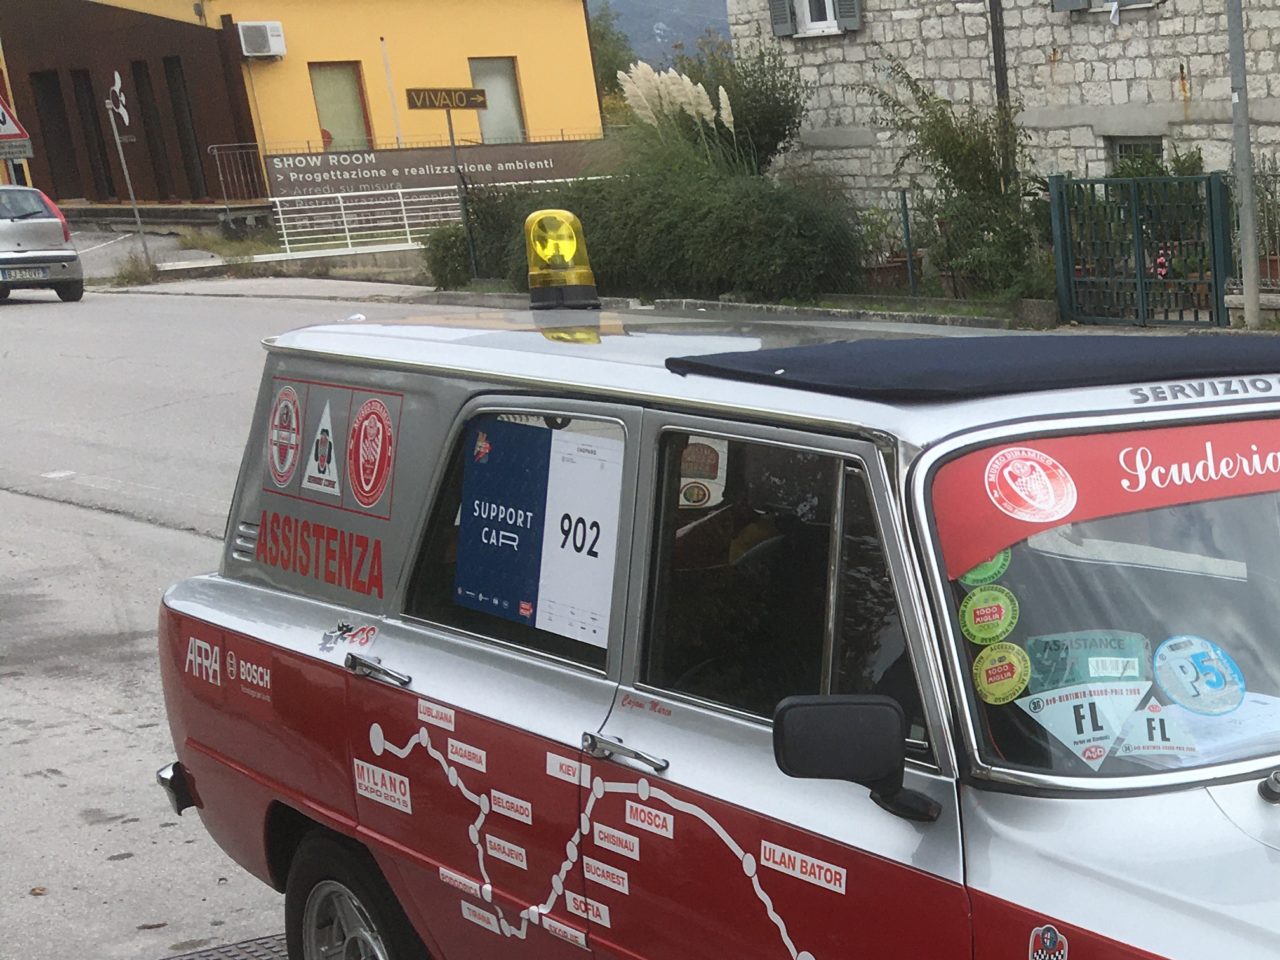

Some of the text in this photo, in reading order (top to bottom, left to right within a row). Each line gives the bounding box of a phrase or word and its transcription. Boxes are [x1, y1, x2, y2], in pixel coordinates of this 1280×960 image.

[411, 91, 467, 107] VIVAIO
[273, 153, 376, 169] SHOW ROOM
[289, 167, 387, 182] Progettazione
[404, 162, 493, 176] realizzazione
[496, 158, 554, 171] ambienti
[359, 180, 403, 192] misura
[1129, 375, 1273, 404] SERVIZIO
[473, 500, 533, 529] SUPPORT
[481, 527, 519, 551] CAR
[560, 513, 601, 558] 902
[256, 510, 384, 599] ASSISTENZA
[975, 606, 998, 616] 1000
[975, 613, 1000, 623] MIGLIA
[1043, 638, 1125, 652] ASSISTANCE
[185, 637, 221, 686] AFRA
[988, 665, 1009, 675] 1000
[239, 660, 271, 689] BOSCH
[988, 671, 1012, 683] MIGLIA
[1031, 701, 1042, 710] 36
[1073, 702, 1104, 735] FL
[1146, 717, 1171, 742] FL
[450, 743, 484, 766] ZAGABRIA
[356, 764, 407, 797] MILANO
[559, 762, 577, 778] KIEV
[357, 782, 409, 808] EXPO 2015
[492, 795, 530, 818] BELGRADO
[629, 805, 669, 833] MOSCA
[488, 839, 524, 863] SARAJEVO
[598, 831, 635, 852] CHISINAU
[585, 862, 626, 888] BUCAREST
[763, 847, 843, 888] ULAN BATOR
[572, 896, 601, 920] SOFIA
